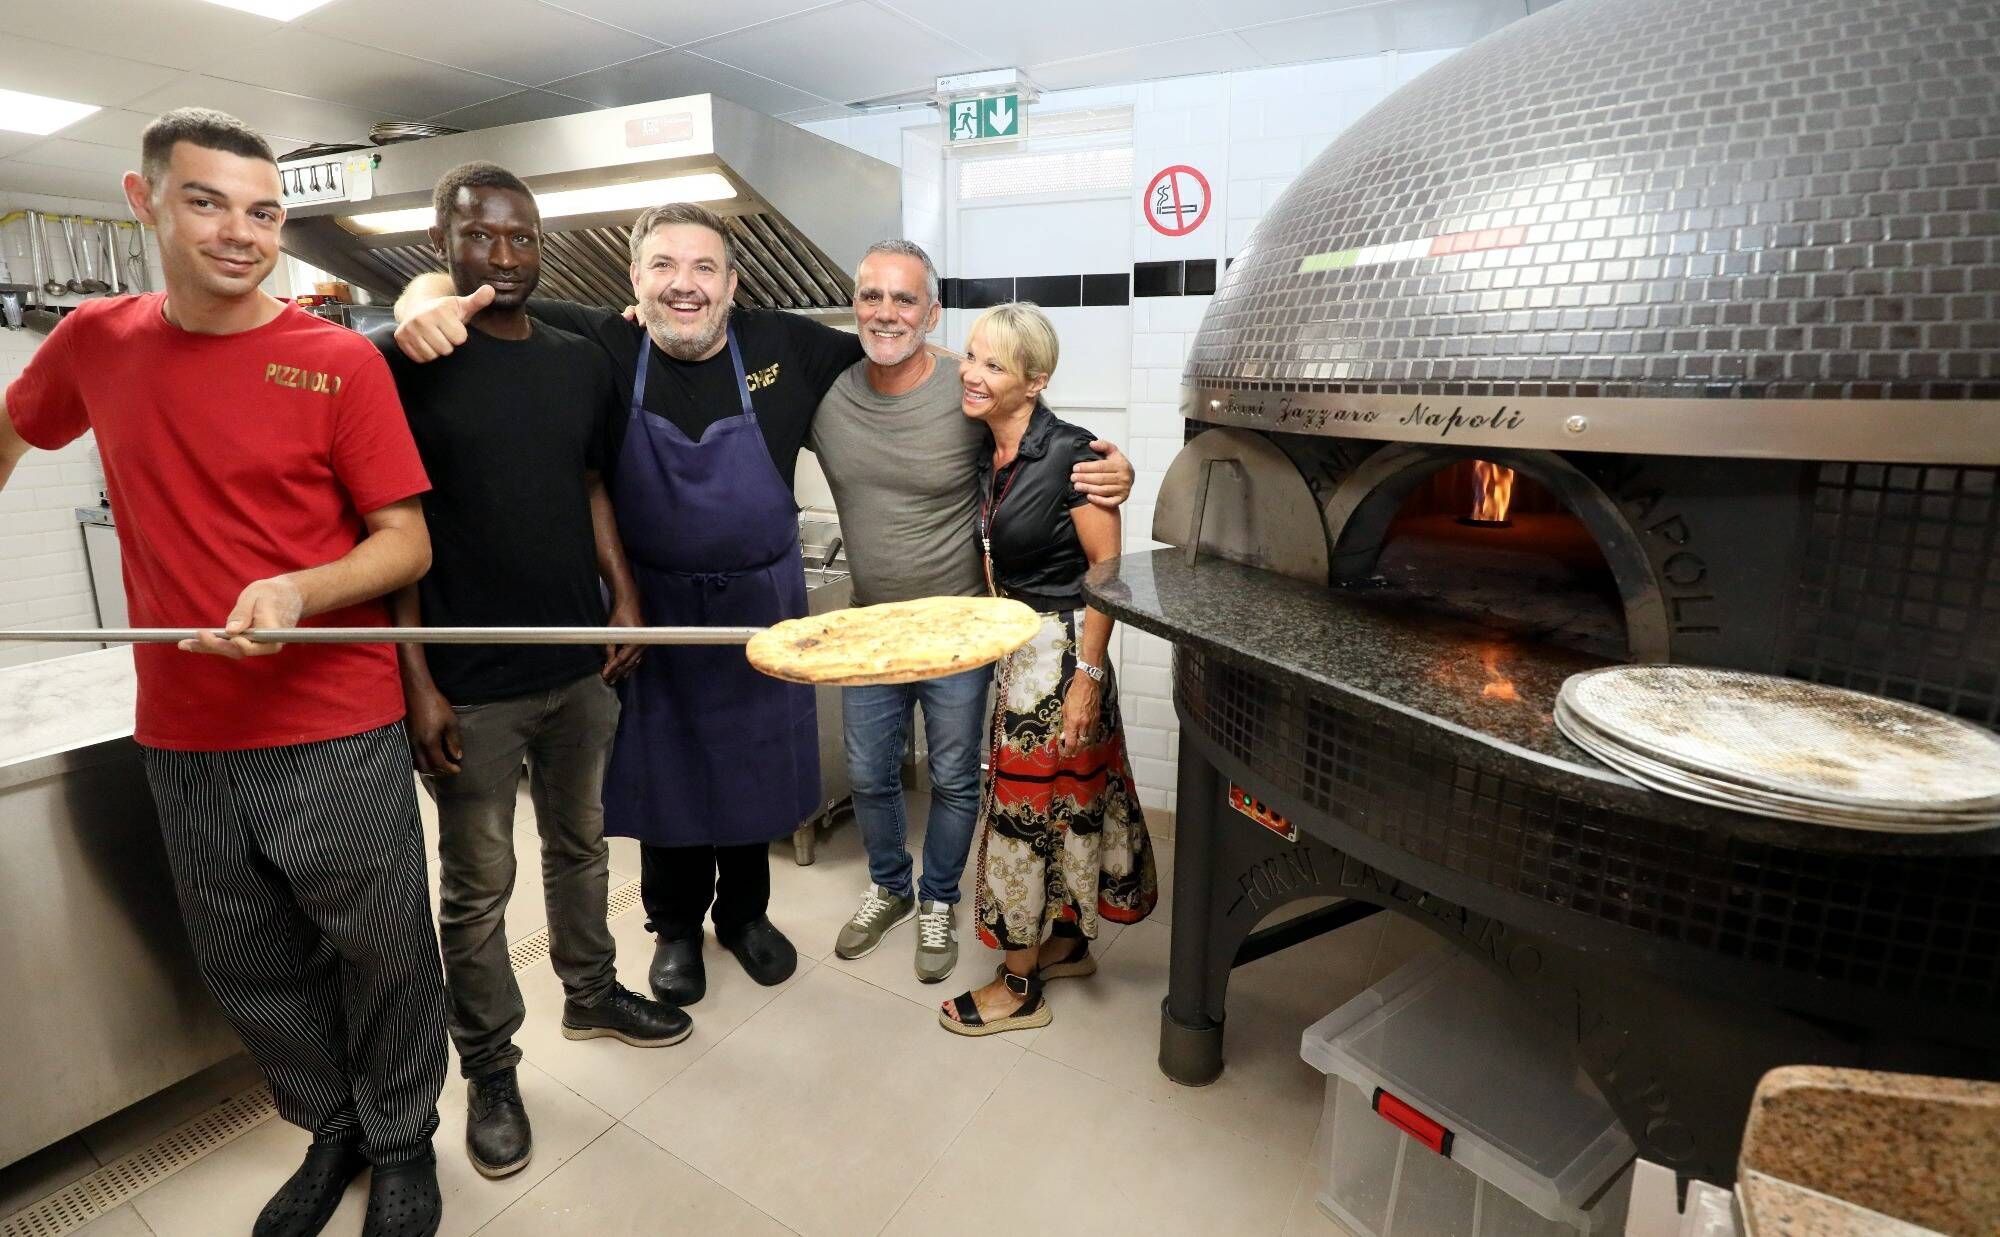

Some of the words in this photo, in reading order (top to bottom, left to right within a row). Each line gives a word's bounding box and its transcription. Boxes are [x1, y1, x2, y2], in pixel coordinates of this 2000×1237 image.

[745, 363, 779, 391] CHEF
[1276, 397, 1380, 430] Zazzaro
[1400, 402, 1525, 437] Napoli
[1238, 847, 1320, 910] FORNI
